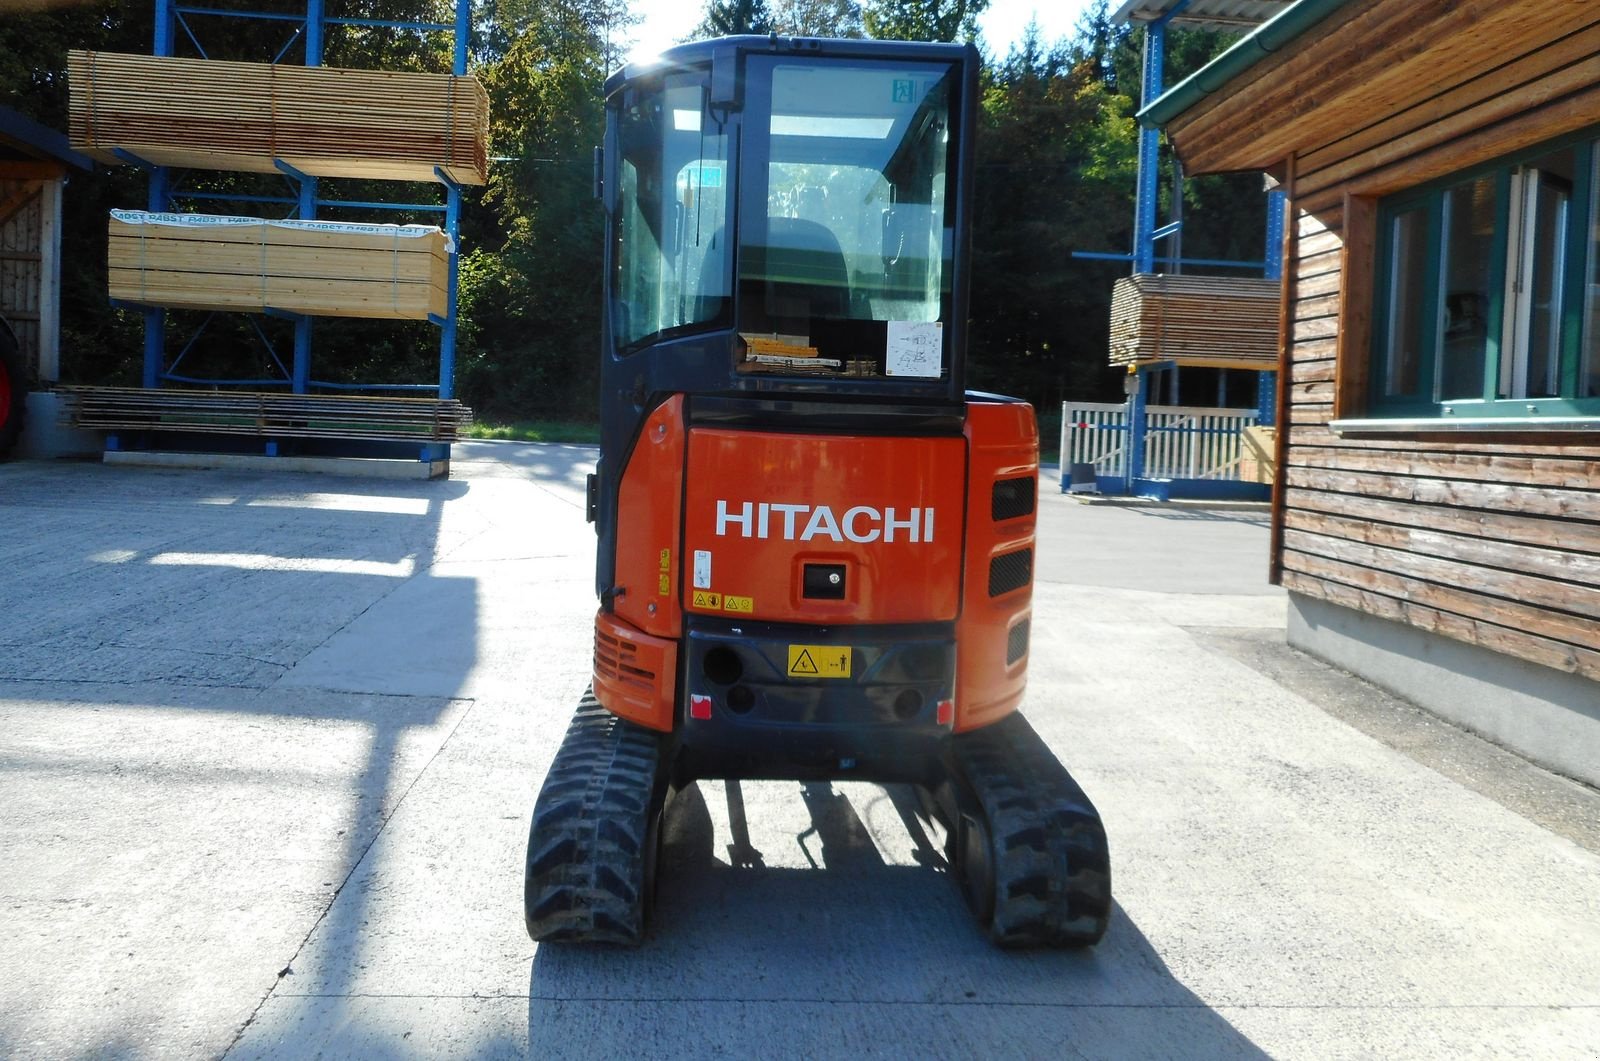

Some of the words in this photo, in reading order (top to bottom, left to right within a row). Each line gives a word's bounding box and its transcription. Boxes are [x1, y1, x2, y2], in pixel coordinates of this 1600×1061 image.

[148, 213, 185, 223] PABST
[188, 216, 222, 224] PABST
[715, 500, 934, 543] HITACHI
